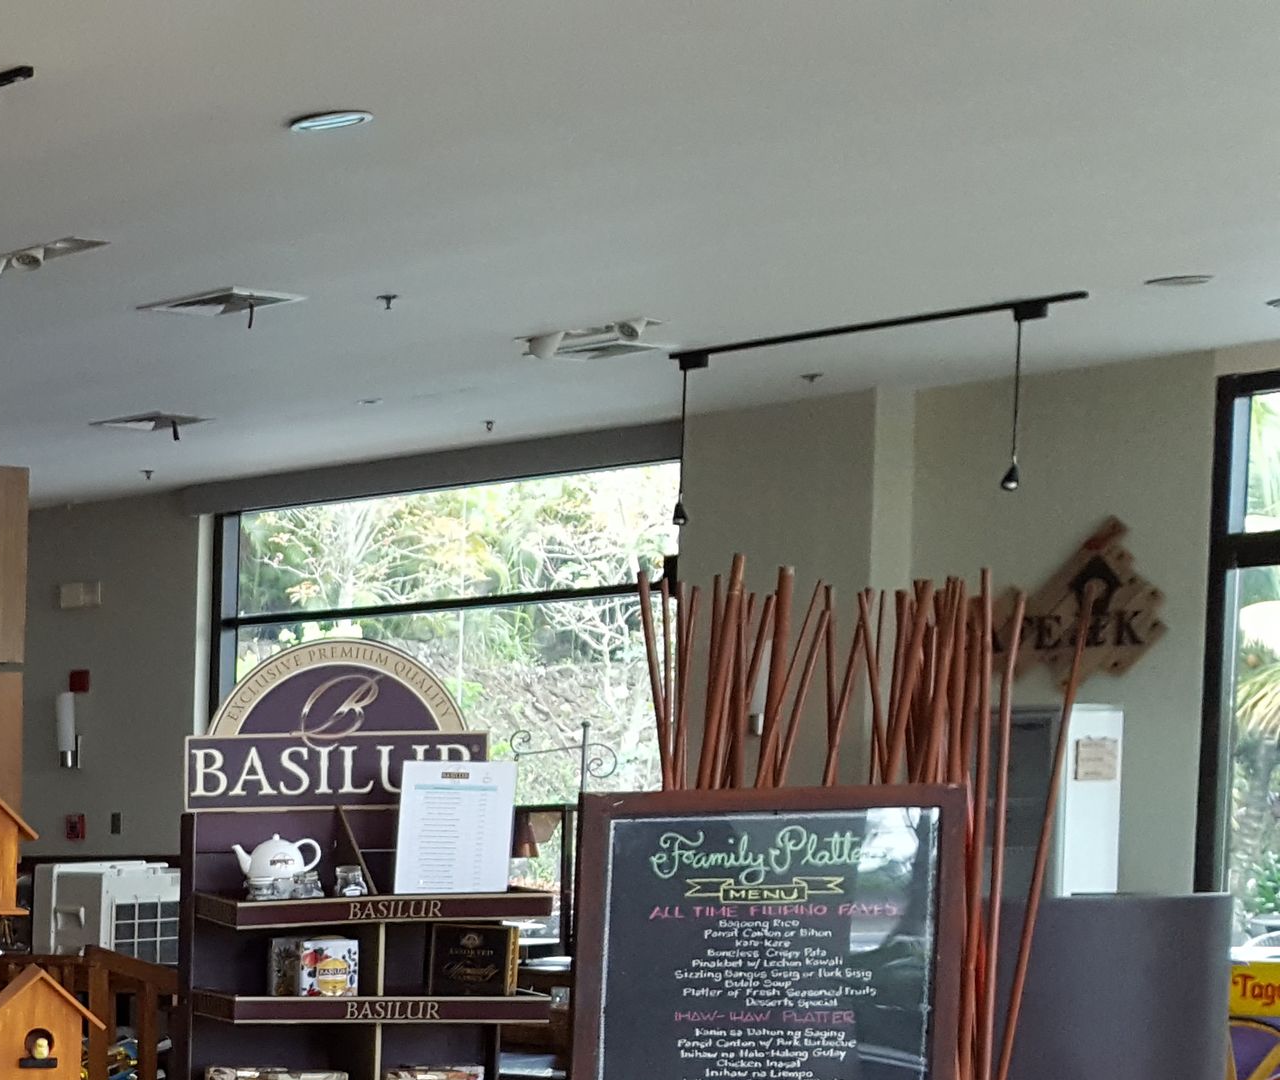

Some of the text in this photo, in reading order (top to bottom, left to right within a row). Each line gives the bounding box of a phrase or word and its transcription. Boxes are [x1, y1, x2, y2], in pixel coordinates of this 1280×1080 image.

[226, 646, 458, 722] EXCLUSIVE PREMIUM QUALITY
[650, 829, 770, 886] Family
[729, 887, 798, 900] MENU
[348, 900, 443, 920] BASILUR
[649, 904, 685, 919] ALL
[693, 904, 738, 918] TIME
[750, 903, 827, 917] FILIPINO
[784, 930, 796, 938] or
[707, 948, 760, 958] Boneless
[766, 949, 800, 959] Crispy
[674, 970, 722, 982] Sizzling
[763, 979, 792, 989] Soup
[683, 987, 723, 997] Platter
[727, 988, 742, 998] of
[746, 988, 780, 997] Fresh
[345, 1001, 441, 1020] BASILUR
[782, 1010, 856, 1024] PLATTER
[787, 1030, 801, 1039] ng
[804, 1028, 846, 1040] Saging
[716, 1059, 762, 1067] Chicken
[705, 1068, 748, 1078] Inihaw
[770, 1069, 814, 1080] Liempo
